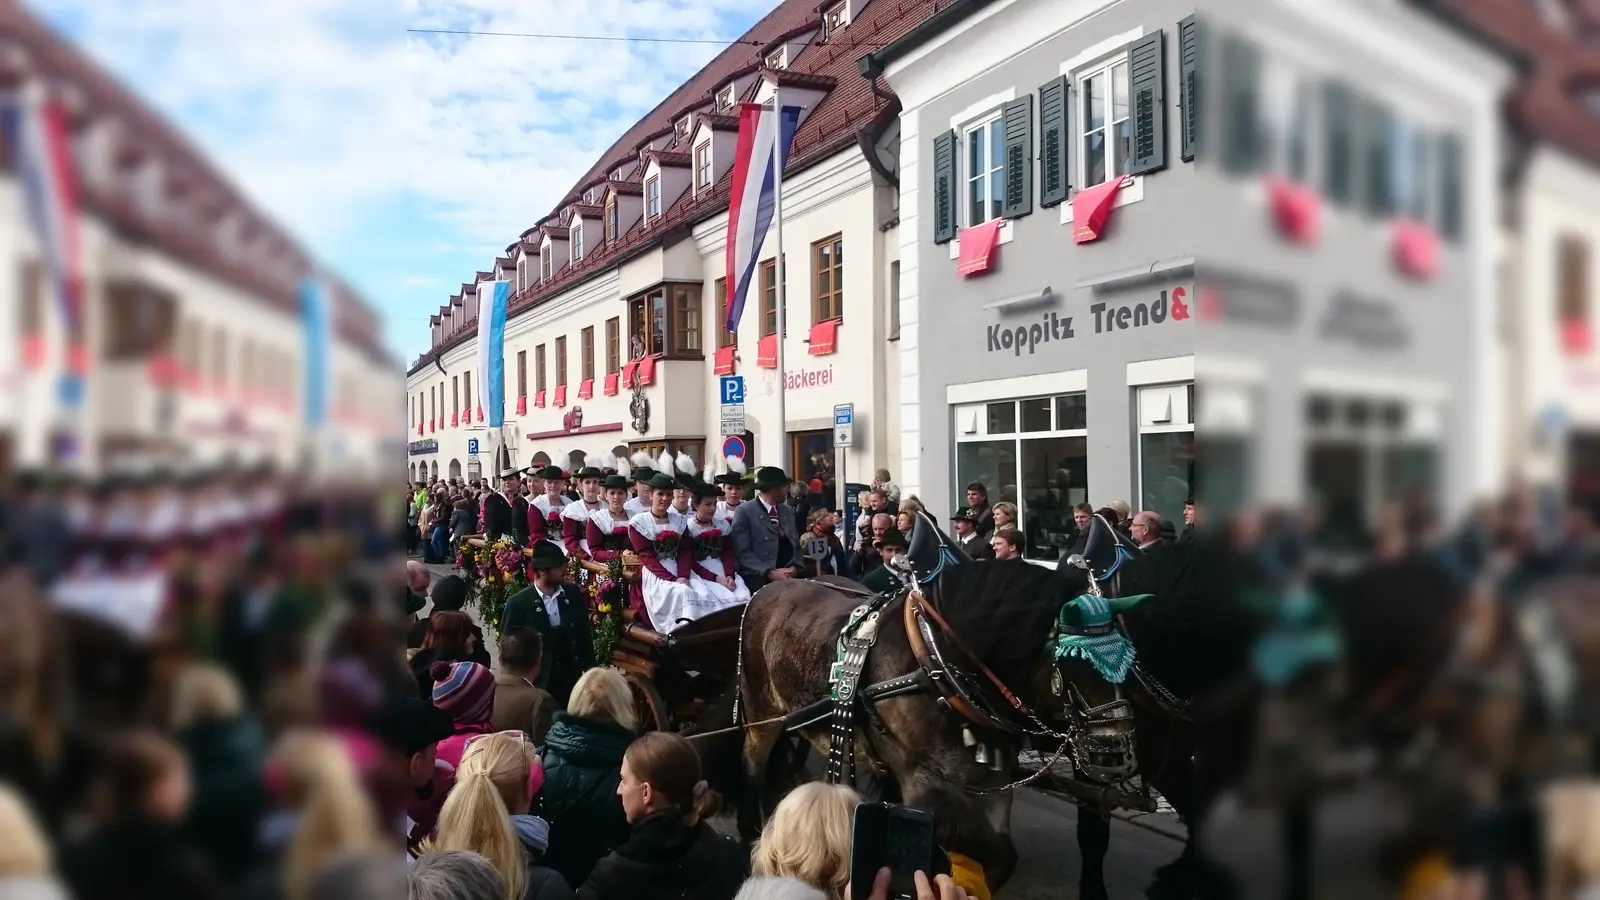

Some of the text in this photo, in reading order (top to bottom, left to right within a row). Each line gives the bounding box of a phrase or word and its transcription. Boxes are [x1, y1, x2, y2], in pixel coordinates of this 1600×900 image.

[987, 312, 1074, 357] Koppitz
[726, 380, 739, 401] P
[811, 541, 825, 555] 13
